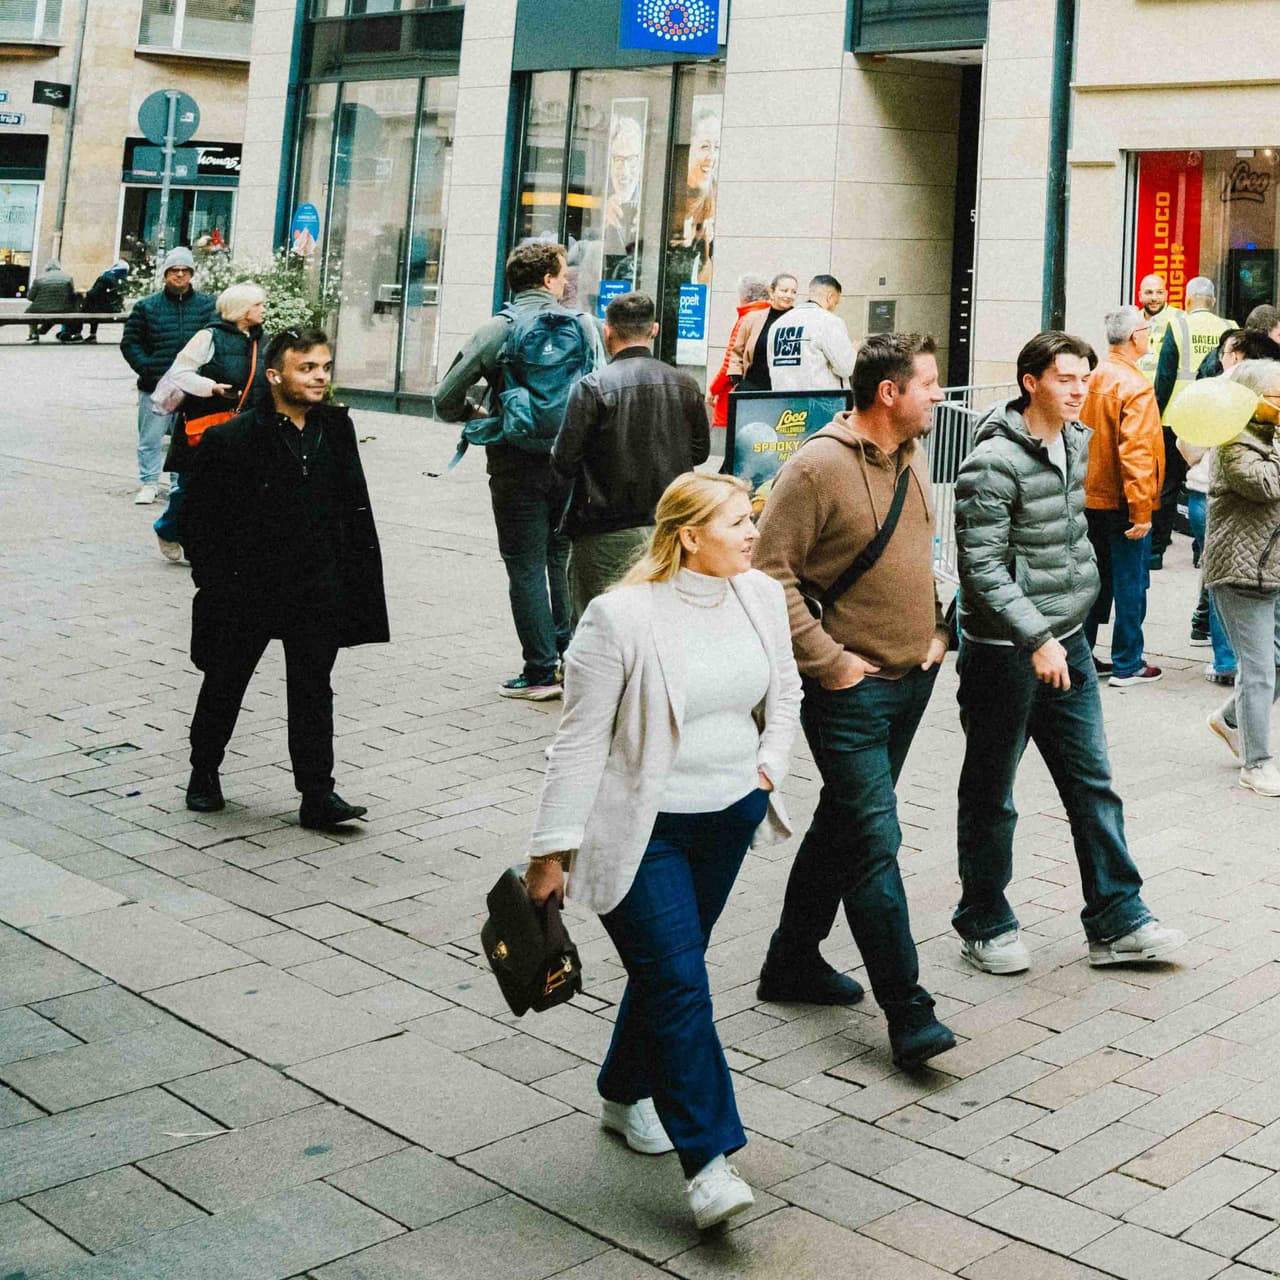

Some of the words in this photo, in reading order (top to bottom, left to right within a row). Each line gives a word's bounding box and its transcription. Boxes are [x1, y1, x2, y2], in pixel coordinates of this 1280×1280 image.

[1154, 191, 1171, 249] LOCO
[680, 293, 700, 310] ppelt
[775, 409, 807, 431] Loco
[753, 440, 799, 453] SPOOKY
